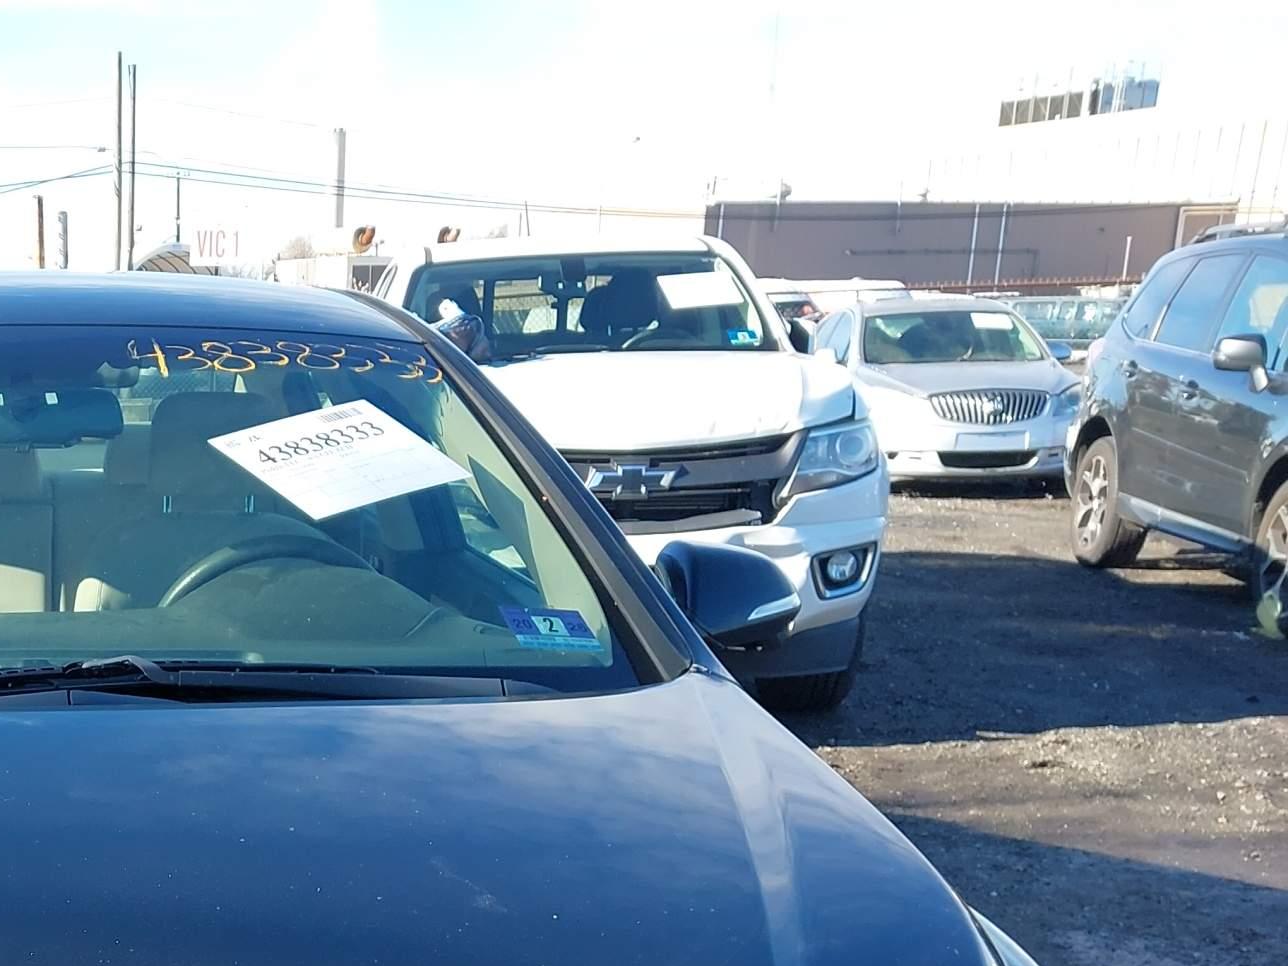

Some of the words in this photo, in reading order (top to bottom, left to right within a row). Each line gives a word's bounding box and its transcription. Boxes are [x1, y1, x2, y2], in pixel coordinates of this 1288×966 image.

[196, 230, 227, 258] VIC
[258, 421, 384, 463] 43838333
[543, 617, 559, 633] 2
